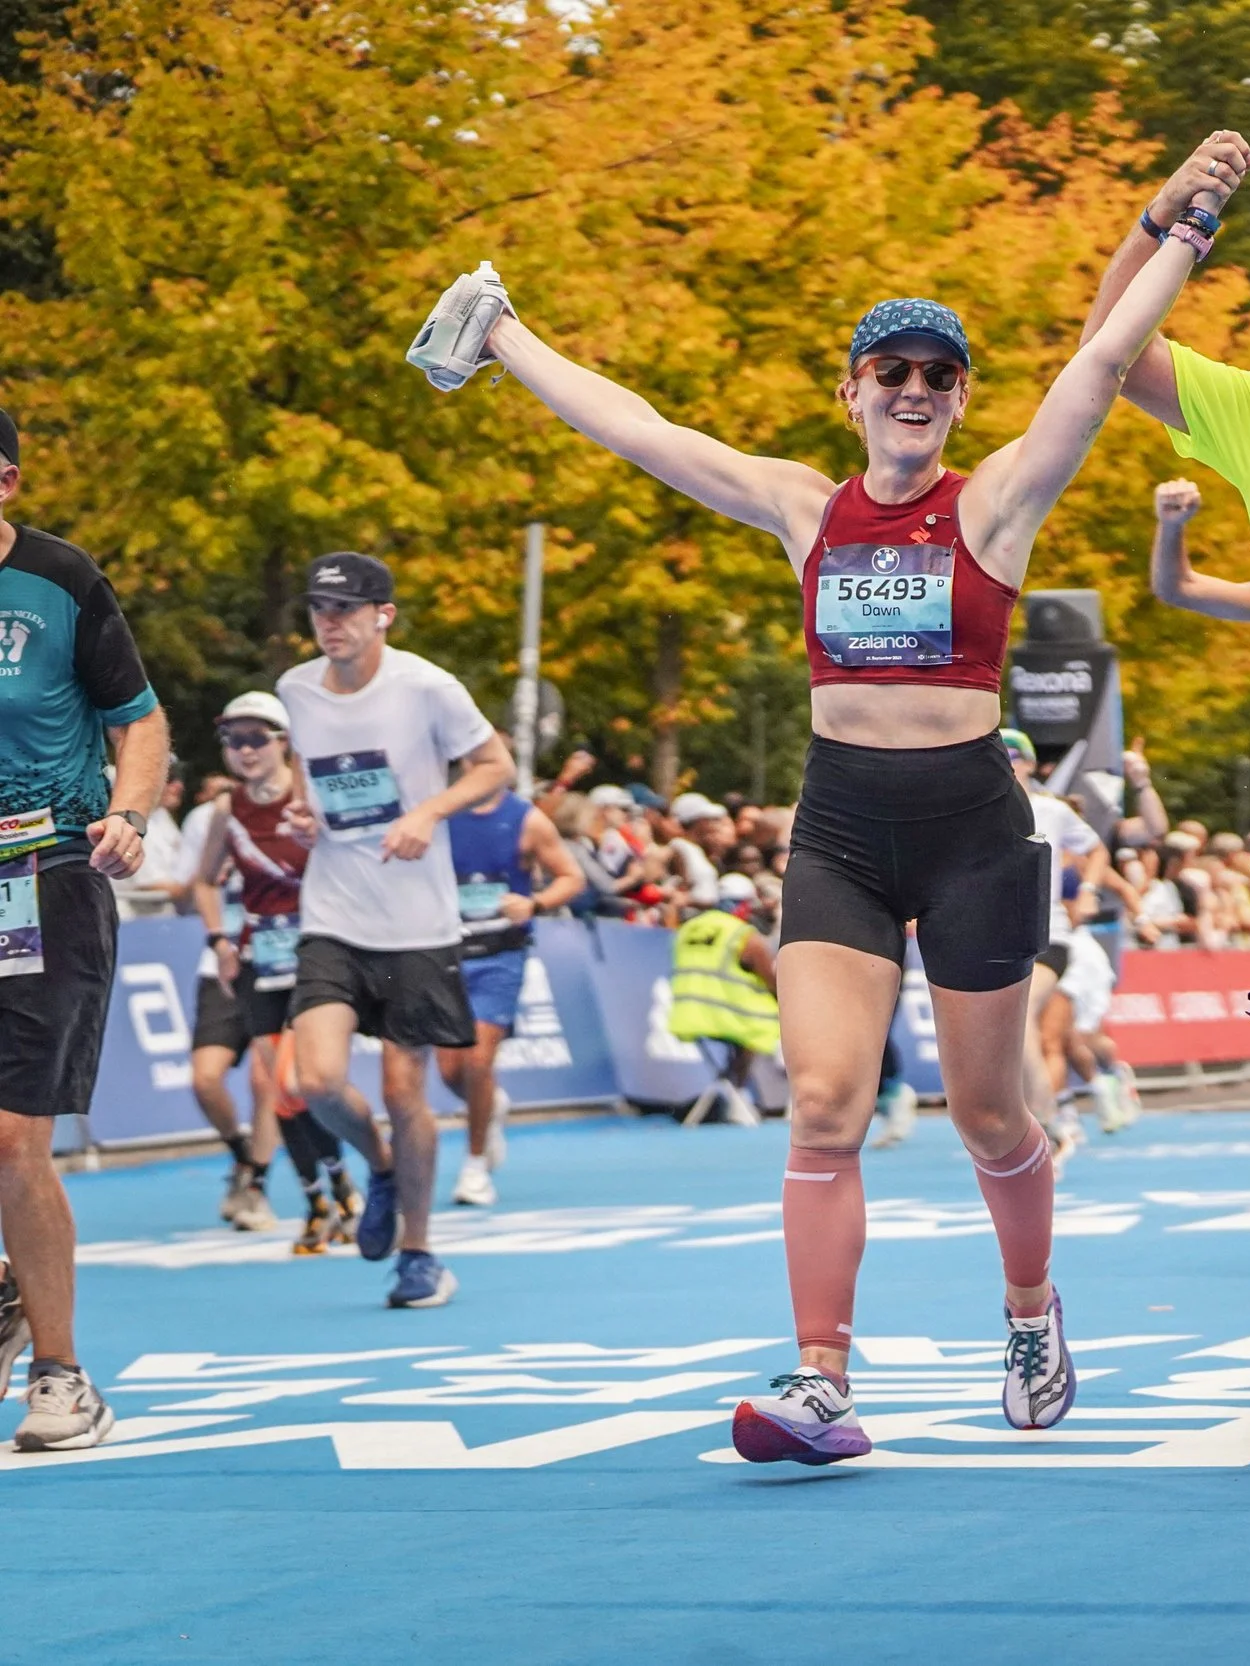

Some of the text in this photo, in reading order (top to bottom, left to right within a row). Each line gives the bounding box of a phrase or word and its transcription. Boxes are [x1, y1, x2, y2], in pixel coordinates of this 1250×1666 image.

[838, 577, 945, 601] 56493 D
[862, 603, 901, 617] Dawn
[848, 634, 919, 649] zalando
